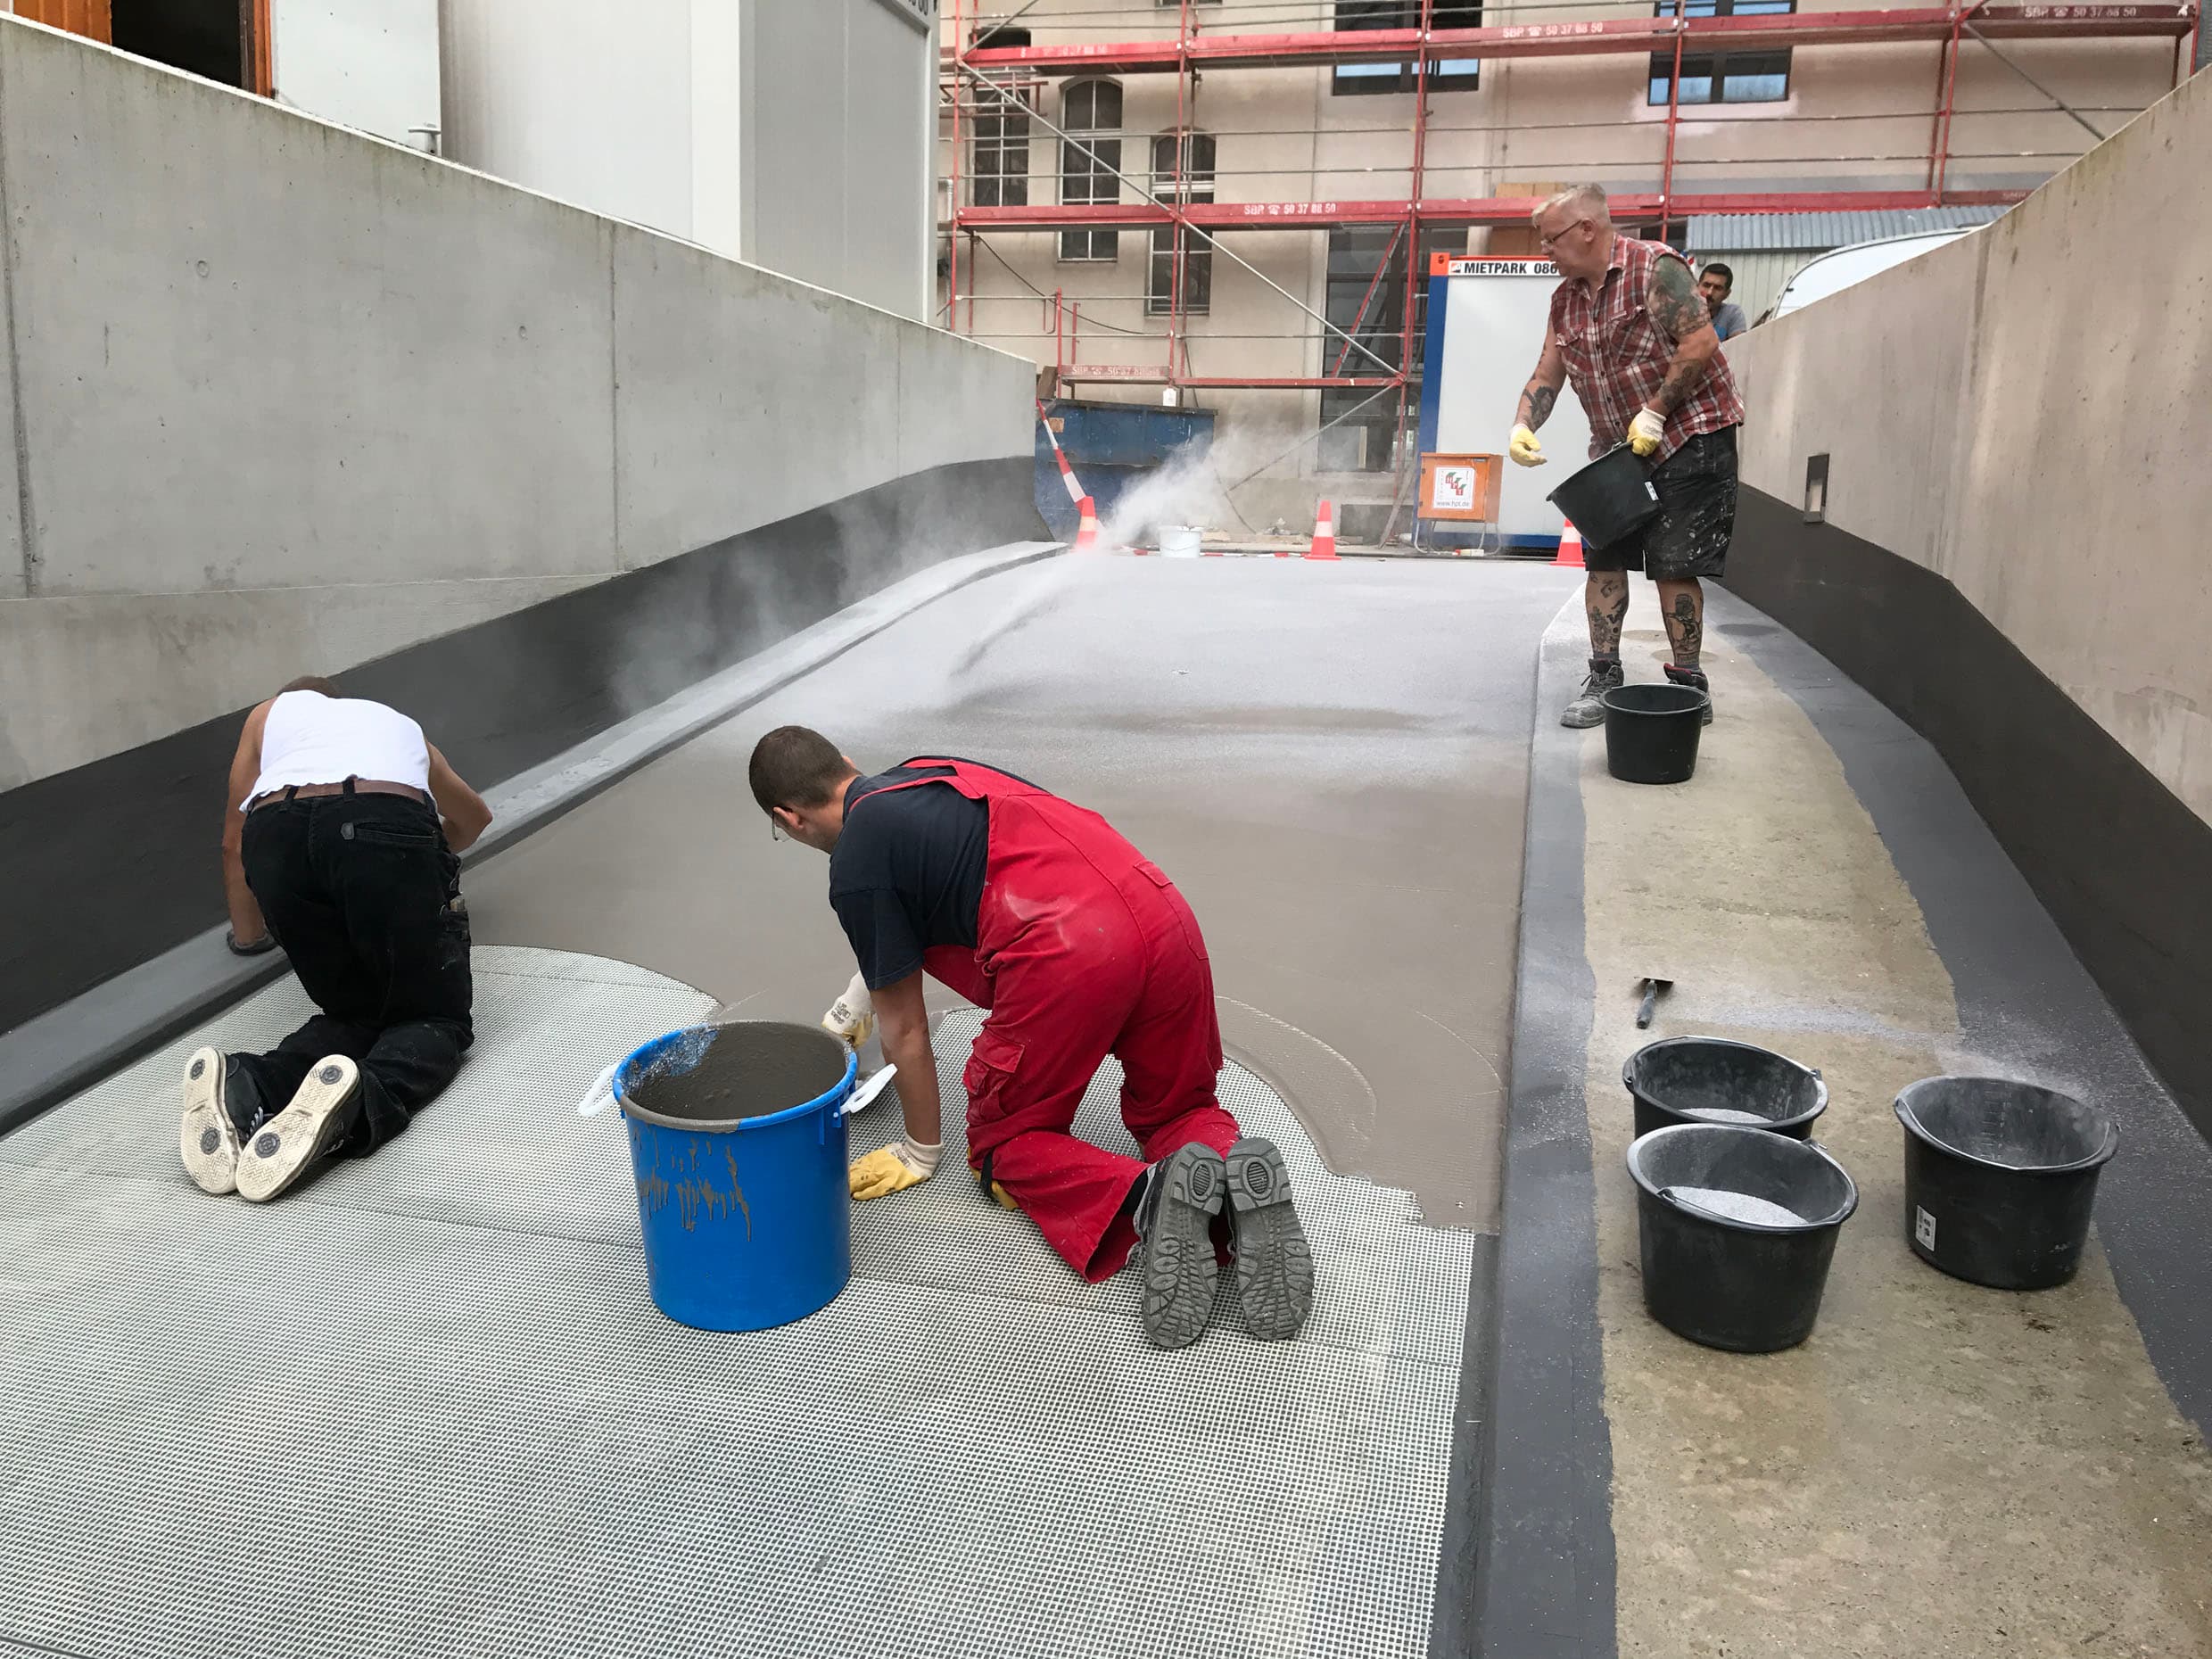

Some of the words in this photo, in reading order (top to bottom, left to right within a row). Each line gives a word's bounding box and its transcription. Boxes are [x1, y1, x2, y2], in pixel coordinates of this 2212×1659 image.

[2123, 6, 2136, 17] 50
[1591, 21, 1603, 33] 50
[1284, 203, 1296, 215] 50
[1298, 203, 1309, 214] 37
[1325, 202, 1336, 213] 50
[1464, 262, 1527, 274] MIETPARK
